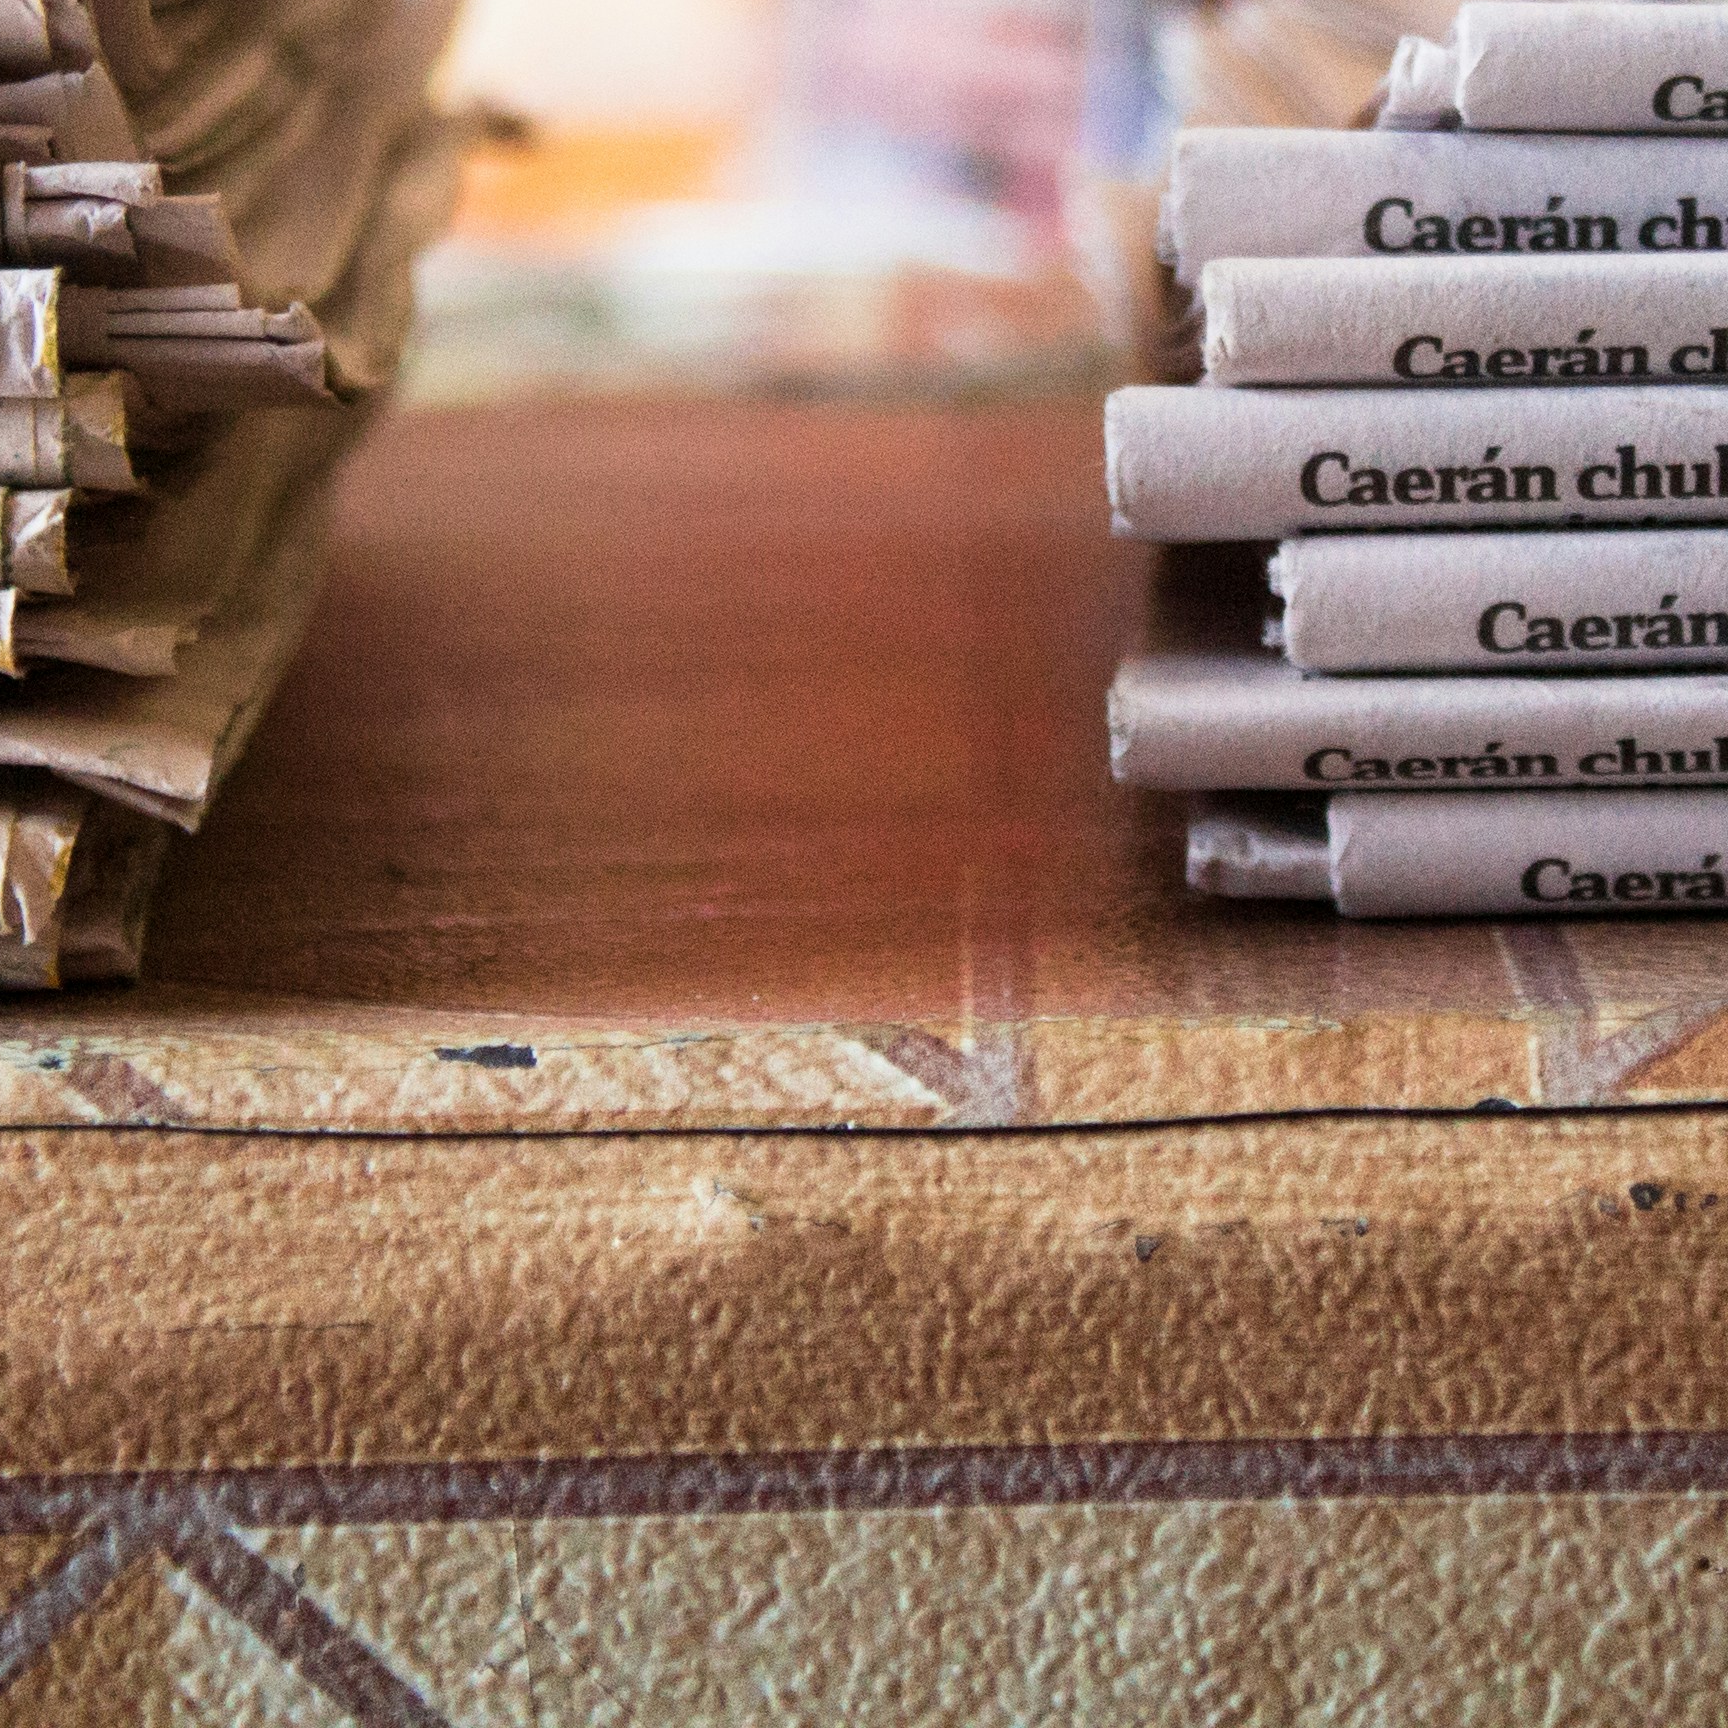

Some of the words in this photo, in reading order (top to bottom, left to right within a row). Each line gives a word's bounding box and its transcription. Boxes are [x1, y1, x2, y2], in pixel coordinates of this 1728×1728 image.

[1362, 196, 1620, 254] Caerán
[1392, 328, 1649, 380] Caerán
[1300, 446, 1558, 507] Caerán
[1302, 742, 1558, 782] Caerán
